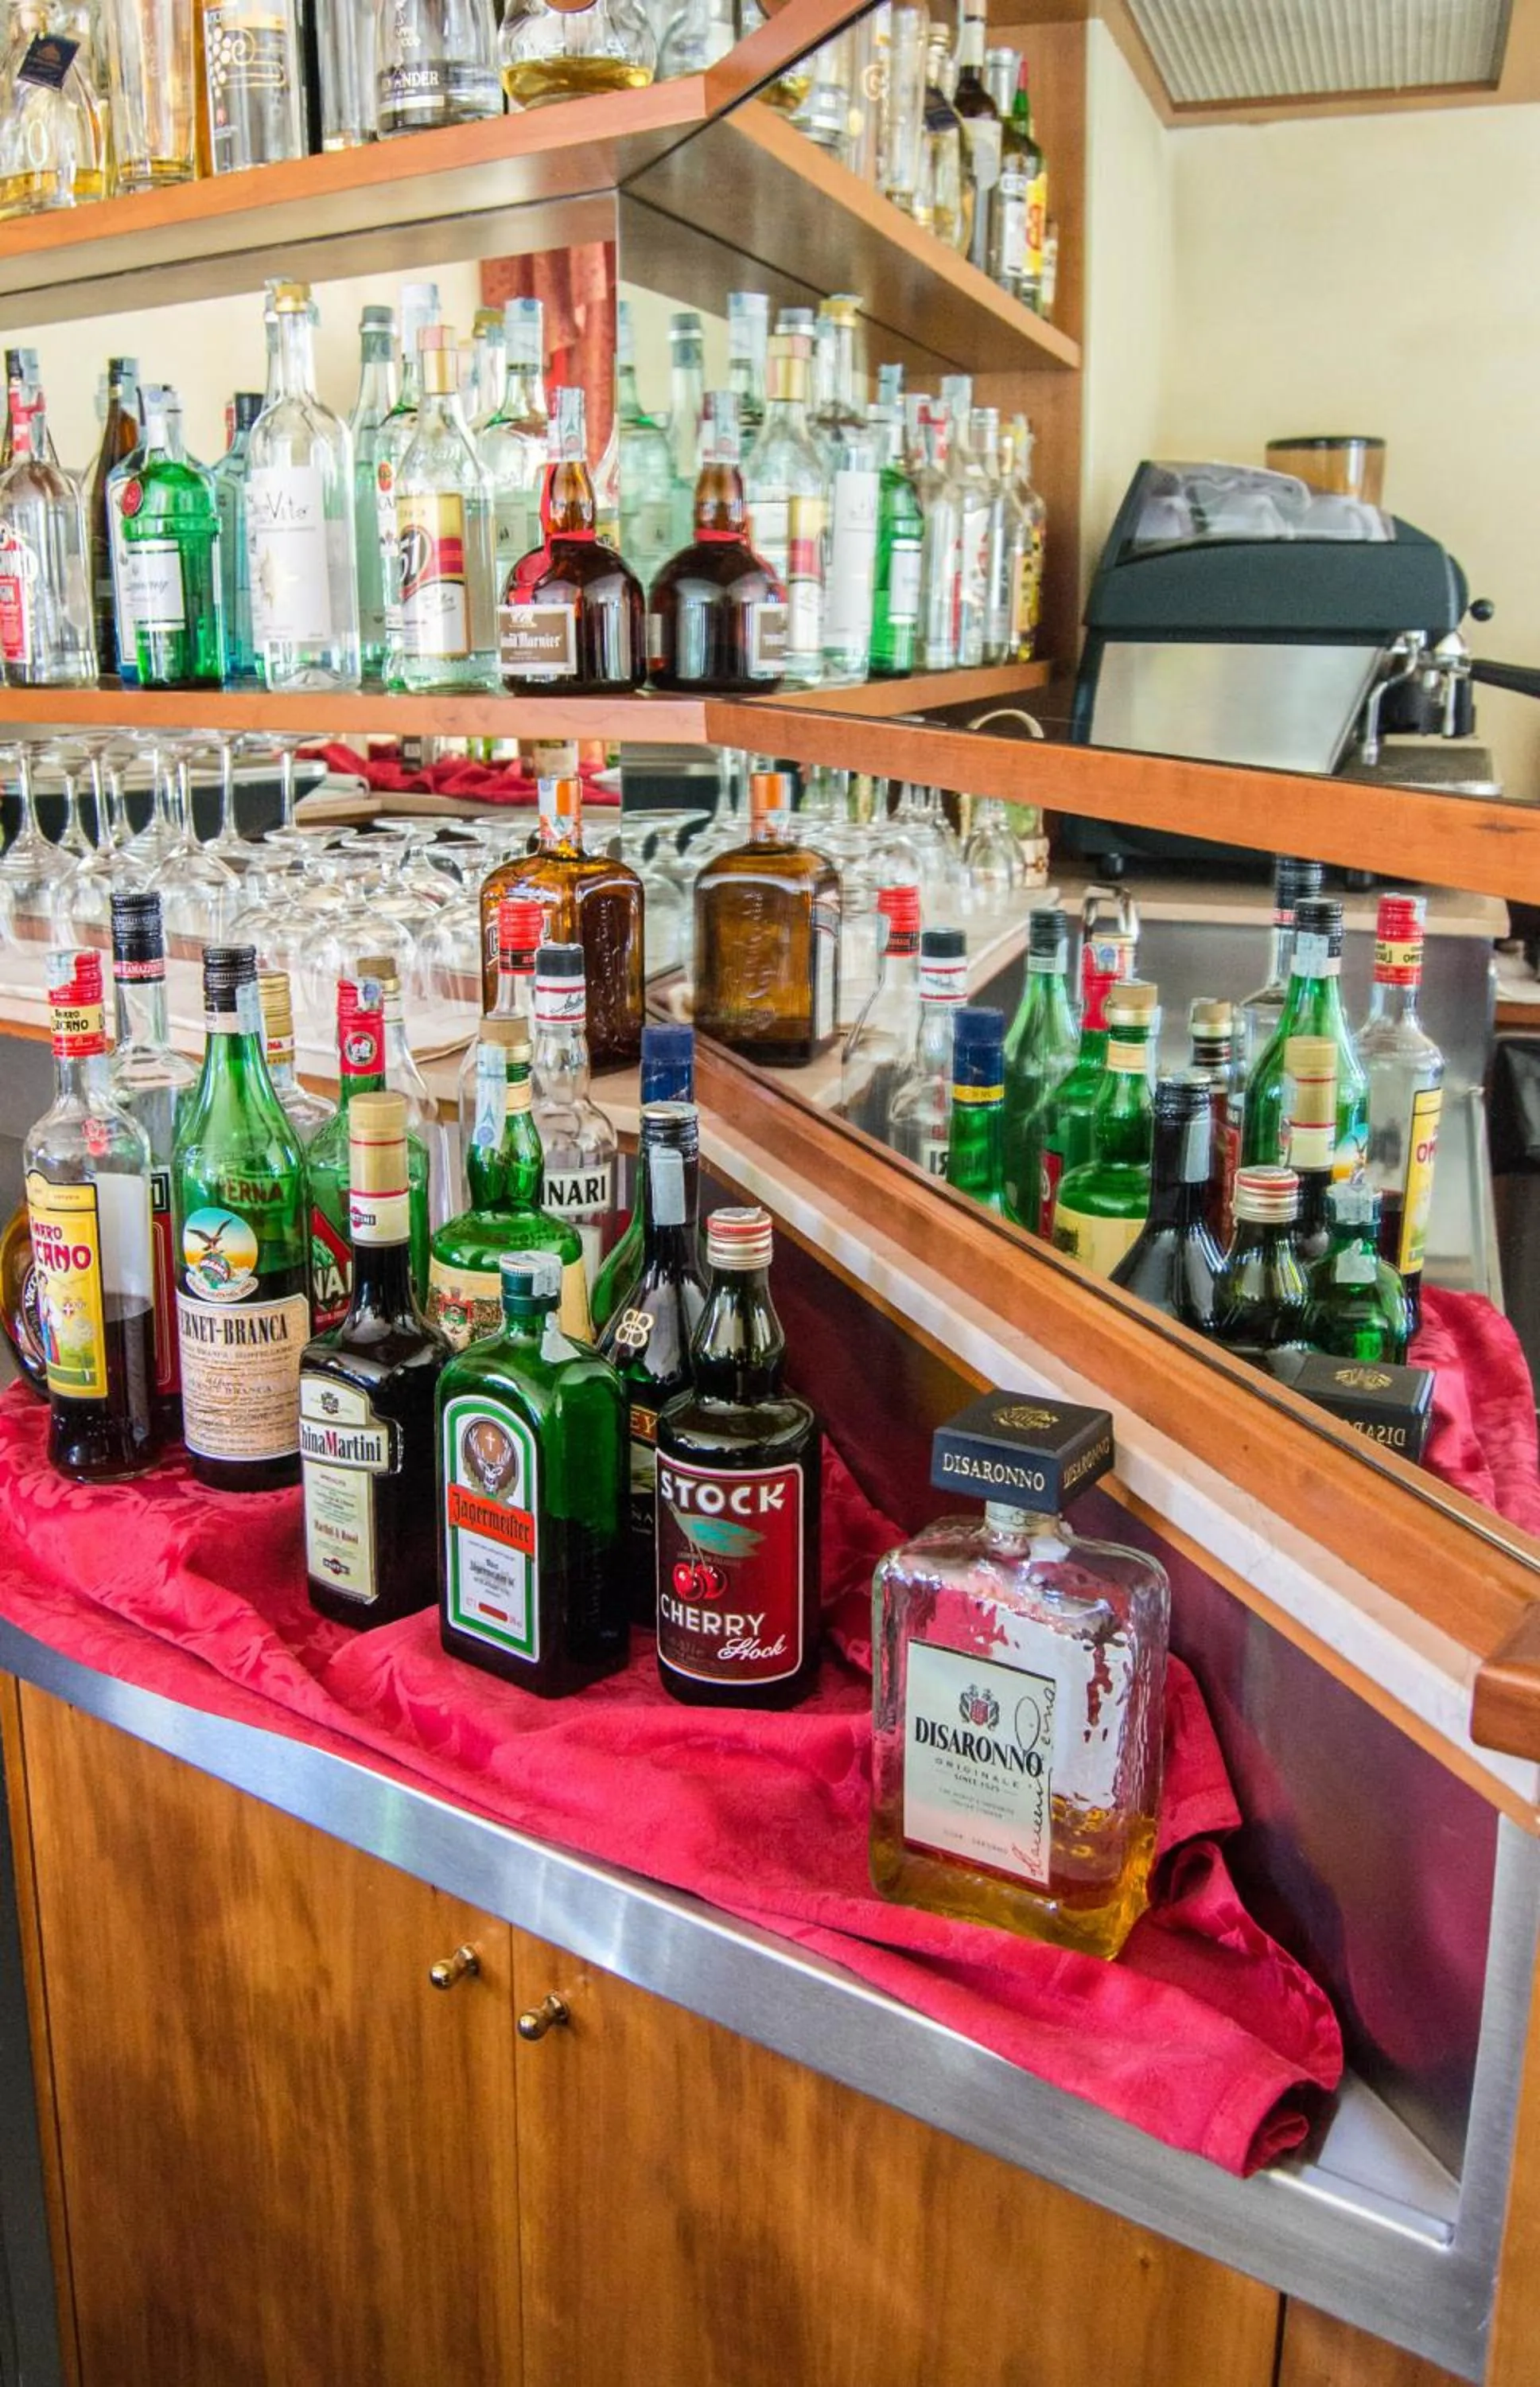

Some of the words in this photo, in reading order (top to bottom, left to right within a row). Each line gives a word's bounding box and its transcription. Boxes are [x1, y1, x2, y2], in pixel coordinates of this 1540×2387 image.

[661, 1470, 786, 1515] STOCK
[943, 1453, 1045, 1492] DISARONNO
[659, 1593, 766, 1637] CHERRY
[718, 1634, 788, 1661] Stock
[915, 1716, 1044, 1778] DISARONNO
[934, 1757, 1020, 1789] ORIGINALE
